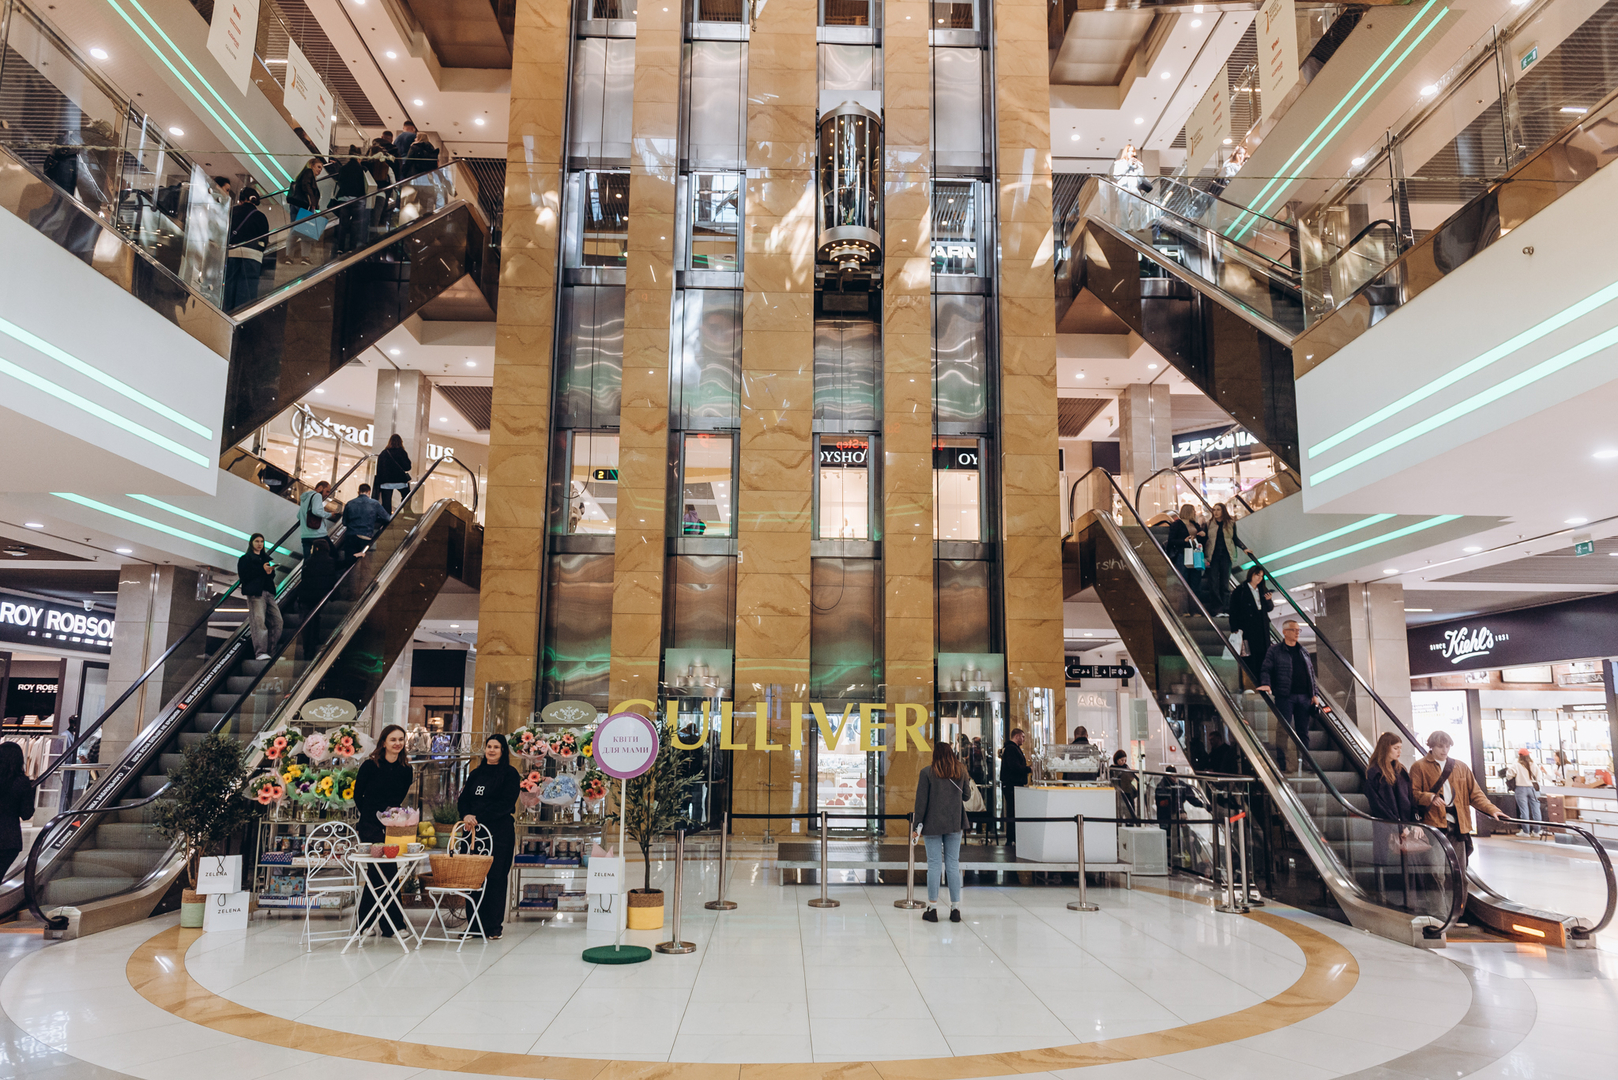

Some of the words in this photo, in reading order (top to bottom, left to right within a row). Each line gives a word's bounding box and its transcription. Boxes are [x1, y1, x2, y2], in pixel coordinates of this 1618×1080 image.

[597, 470, 605, 479] 2
[0, 602, 44, 627] ROY
[46, 609, 116, 639] ROBSO
[1442, 626, 1494, 658] Kiehl's
[17, 683, 35, 691] ROY
